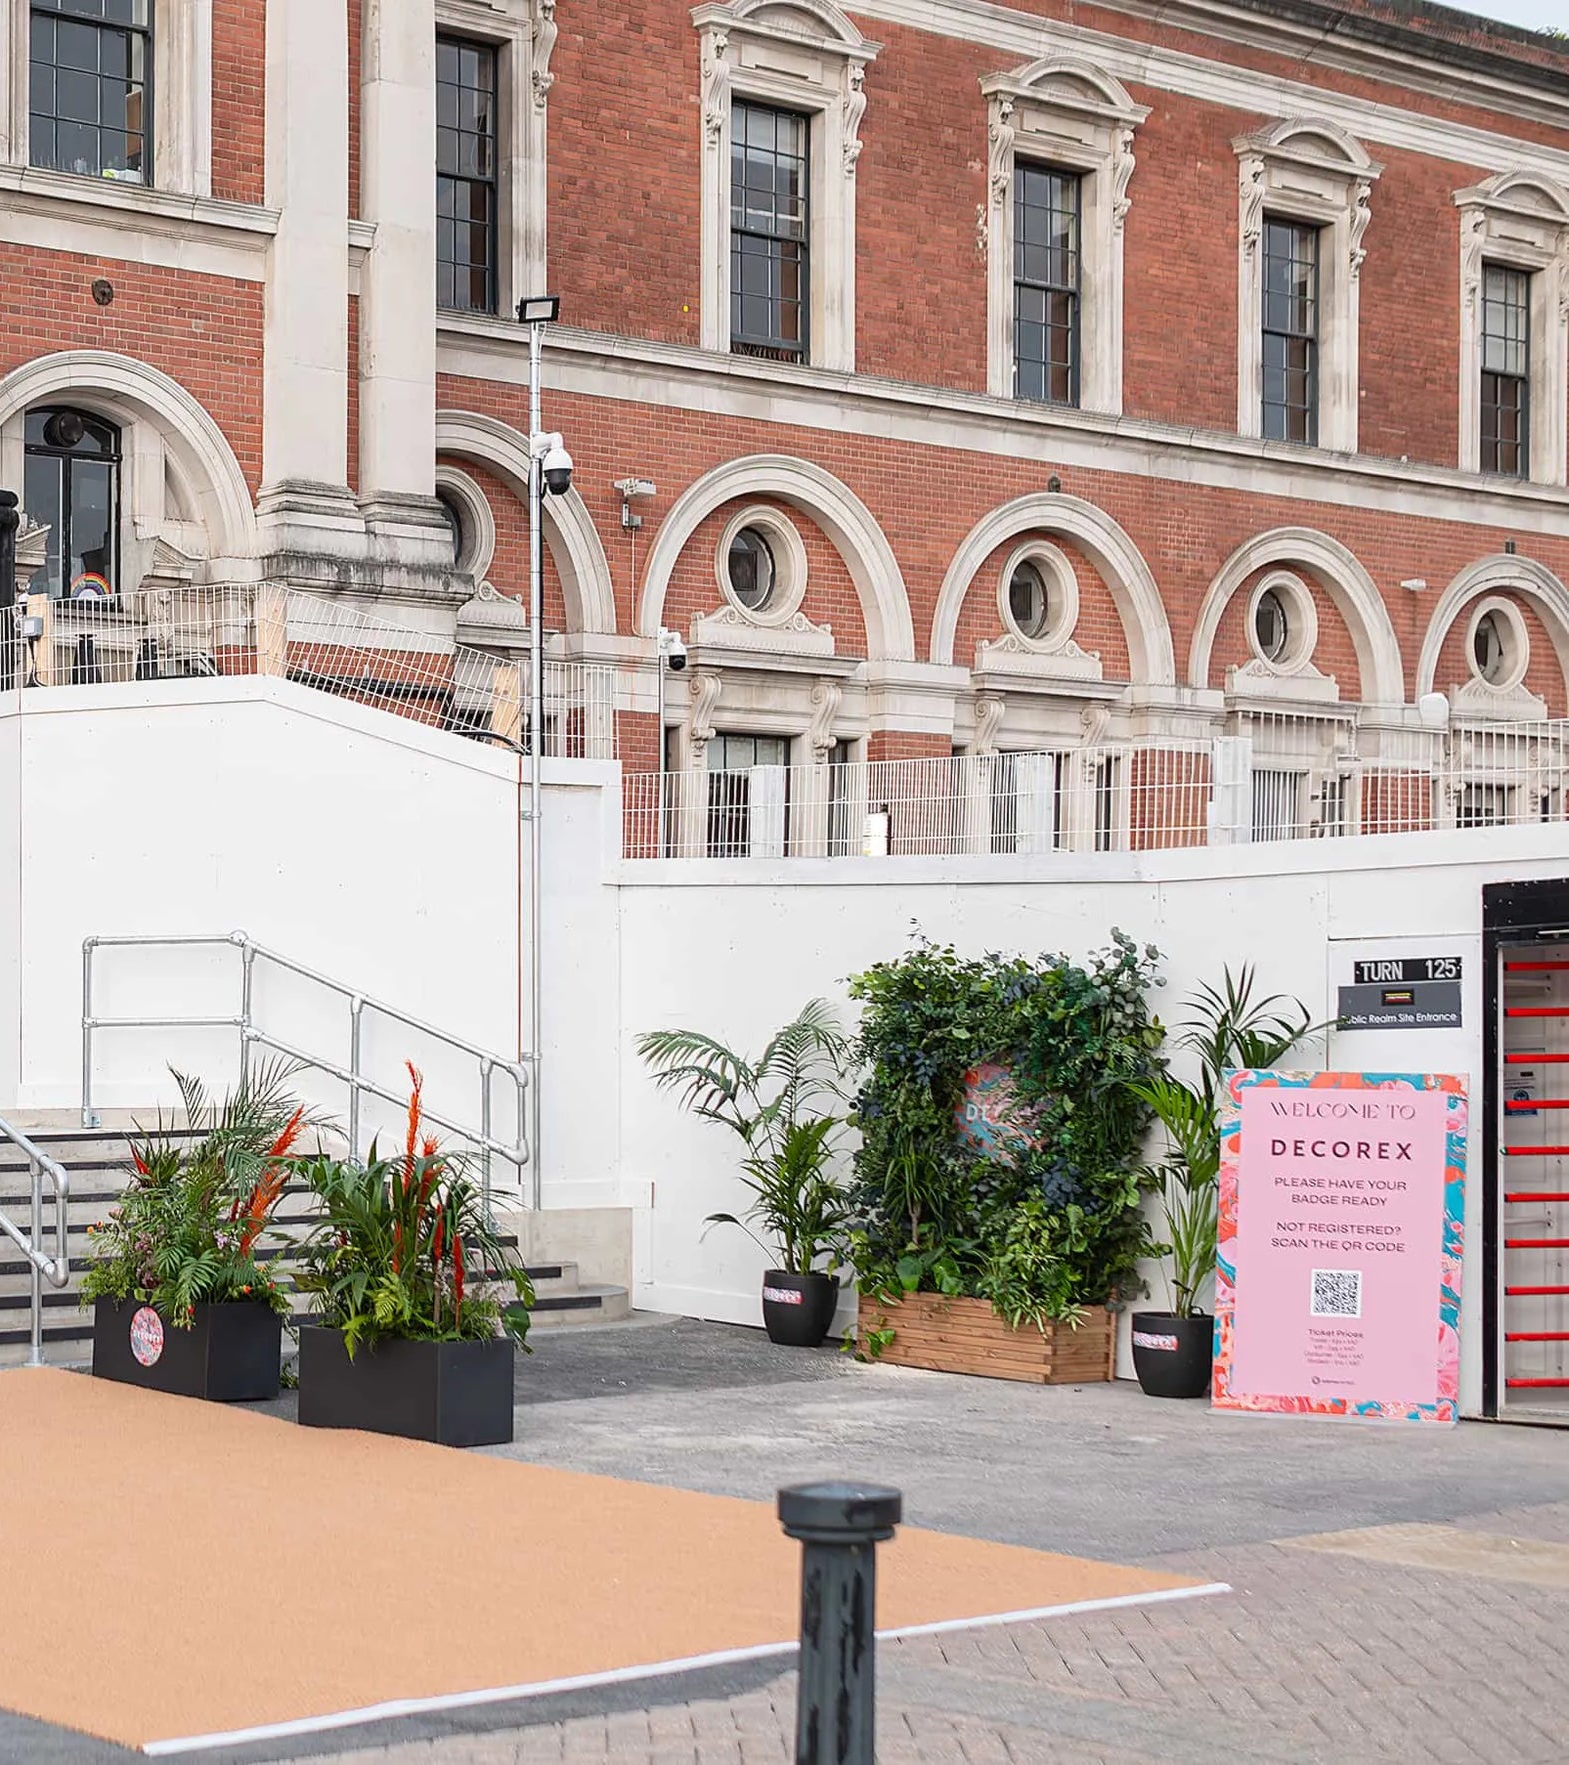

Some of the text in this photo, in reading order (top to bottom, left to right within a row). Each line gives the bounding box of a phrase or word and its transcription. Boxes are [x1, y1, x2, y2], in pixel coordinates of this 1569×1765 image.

[1360, 960, 1456, 982] TURN 125
[1368, 1013, 1397, 1024] Realm
[1398, 1012, 1415, 1023] Site
[1416, 1011, 1457, 1022] Entrance
[1270, 1101, 1416, 1120] WELCOME TO
[1271, 1139, 1412, 1160] DECOREX
[1274, 1177, 1407, 1191] PLEASE HAVE YOUR
[1291, 1194, 1387, 1206] BADGE READY
[1277, 1222, 1402, 1235] NOT REGISTERED?
[1271, 1237, 1406, 1252] SCAN THE QR CODE
[1308, 1329, 1335, 1337] Ticket
